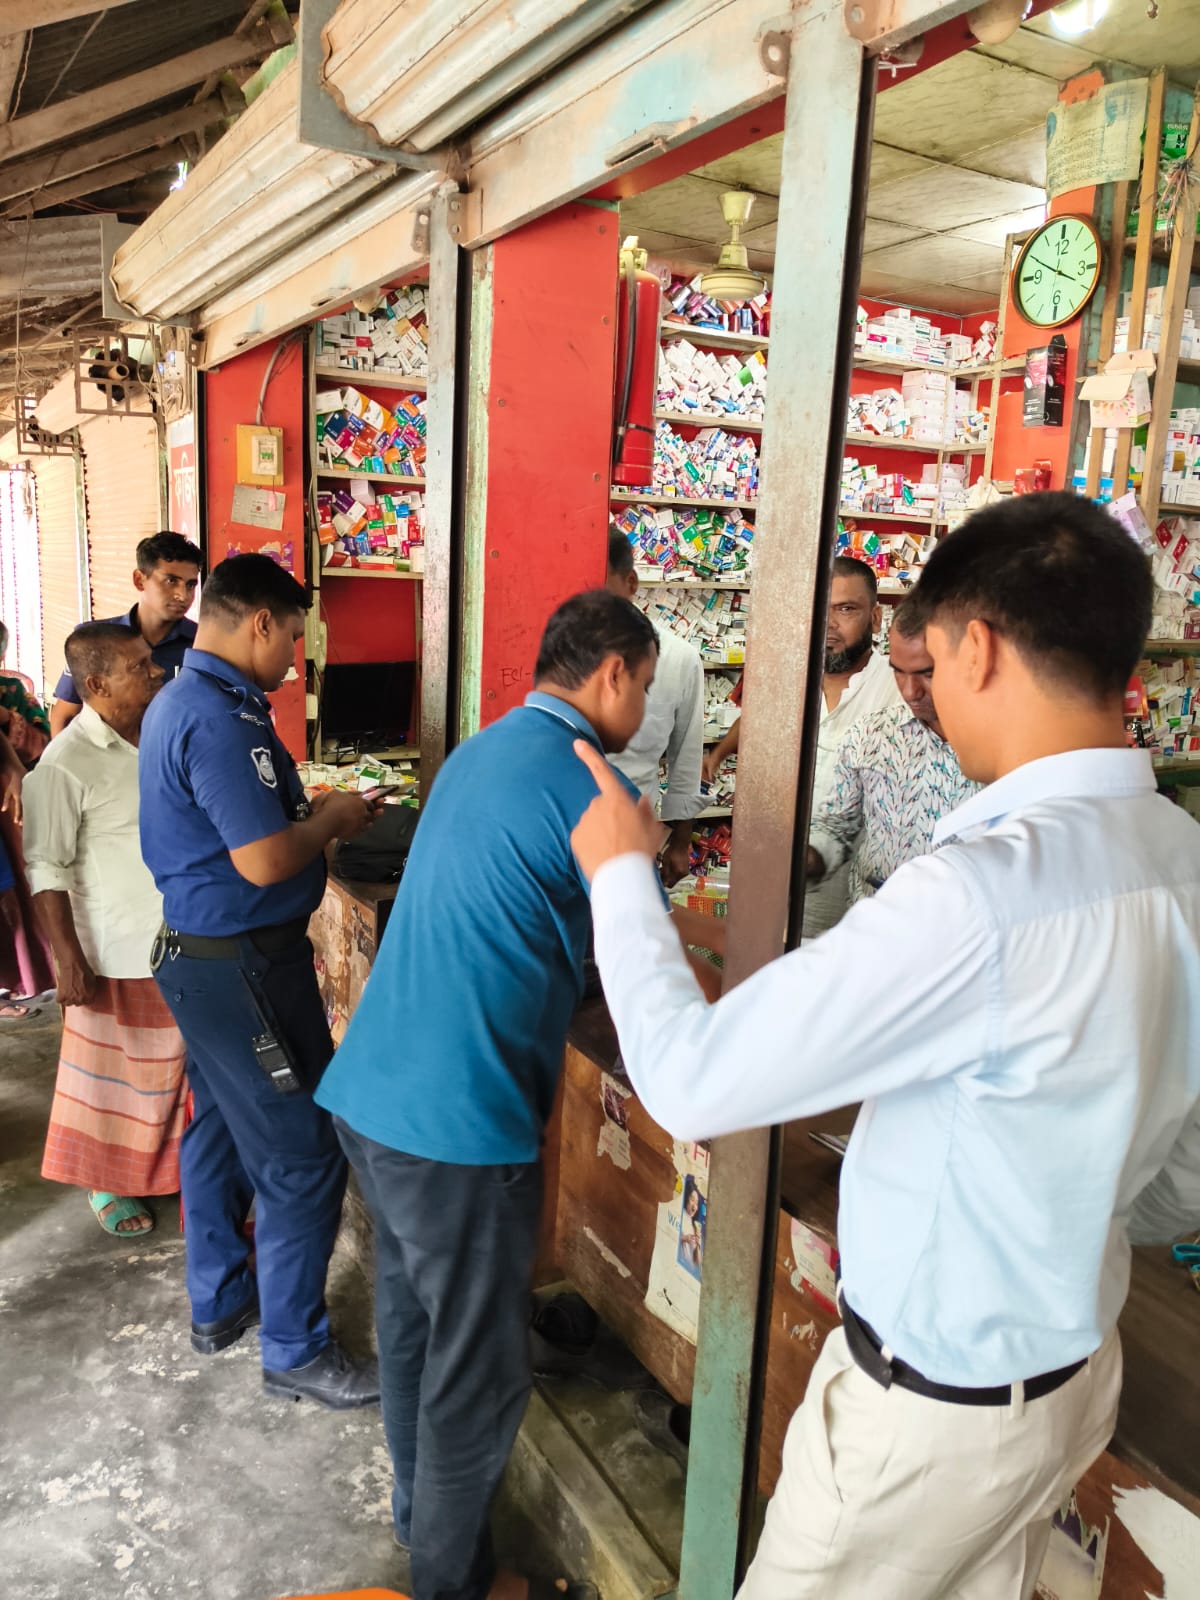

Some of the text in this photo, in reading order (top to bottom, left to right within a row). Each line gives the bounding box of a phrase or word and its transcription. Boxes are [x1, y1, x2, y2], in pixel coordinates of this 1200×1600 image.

[1055, 239, 1070, 256] 12
[1077, 260, 1086, 276] 3
[1033, 269, 1043, 285] 9
[1052, 289, 1062, 305] 6
